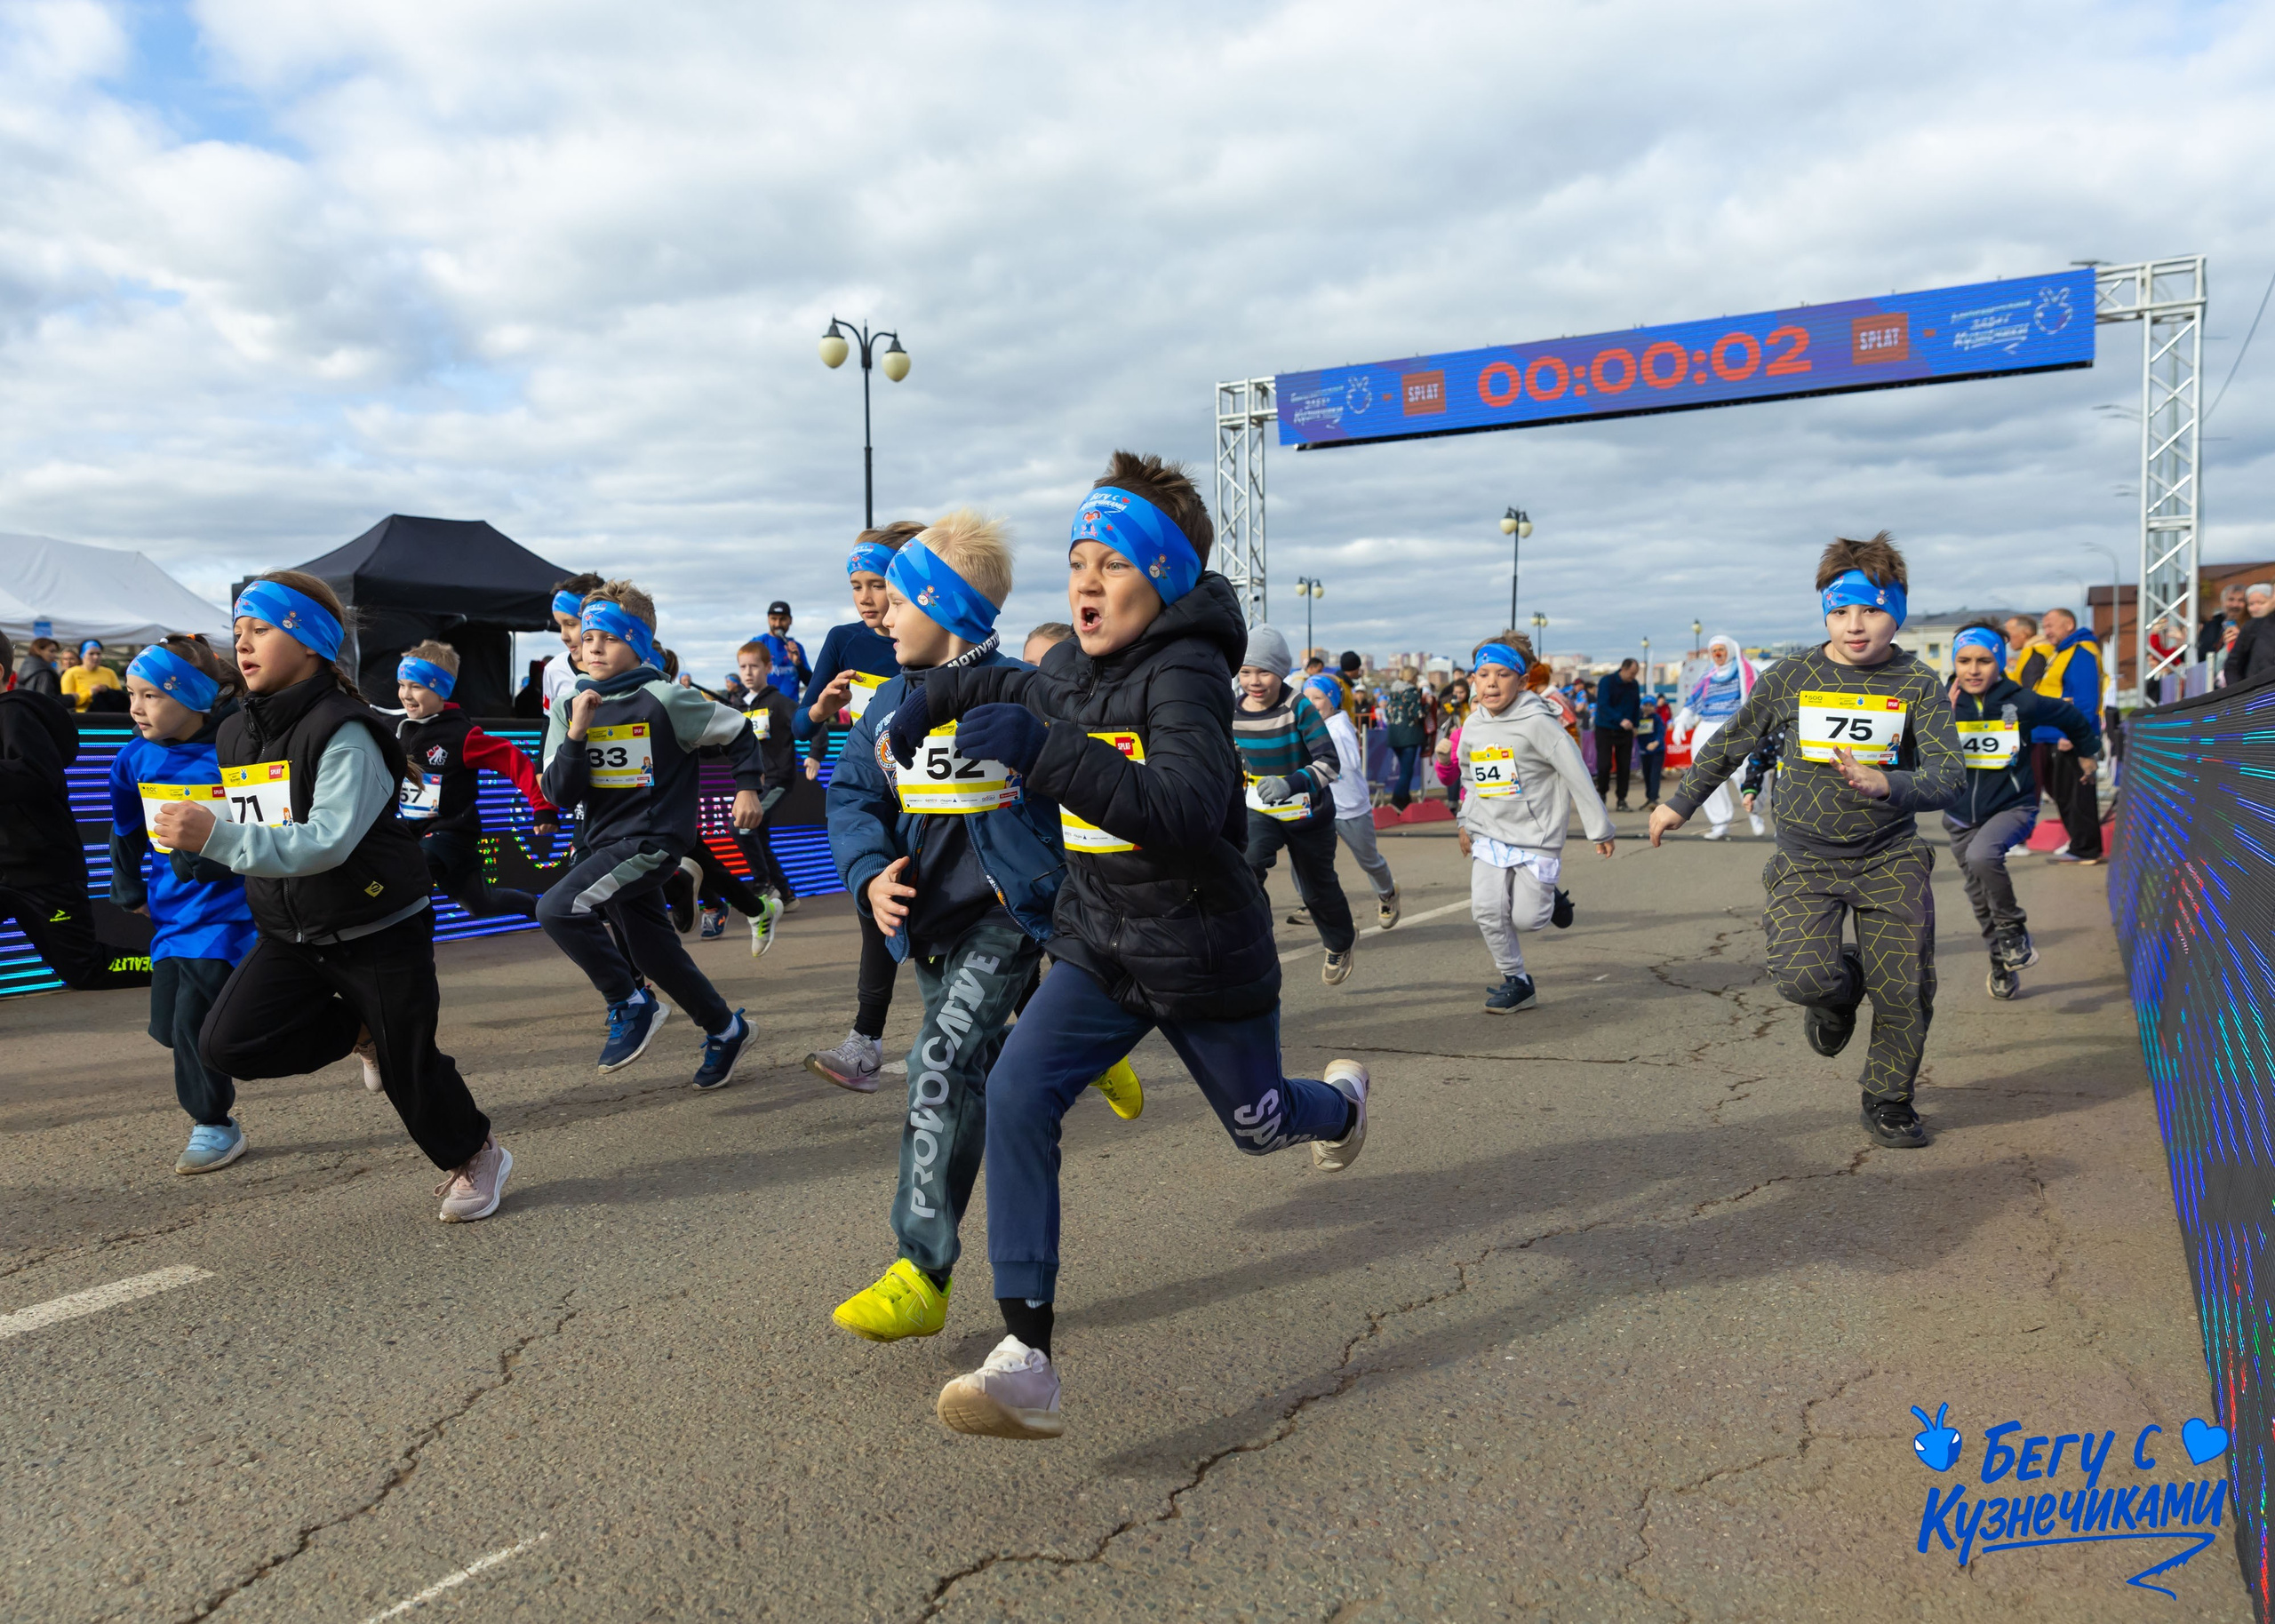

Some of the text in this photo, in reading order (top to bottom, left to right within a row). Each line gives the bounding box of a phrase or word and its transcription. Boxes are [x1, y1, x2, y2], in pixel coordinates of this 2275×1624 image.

[1859, 327, 1901, 351] SPLAT
[1478, 325, 1812, 408] 00:00:02
[1407, 383, 1440, 403] SPLAT
[1825, 716, 1872, 742] 75
[1117, 741, 1131, 751] SPLAT
[1963, 736, 2000, 753] 49
[926, 747, 986, 781] 52
[1475, 765, 1501, 782] 54
[231, 795, 264, 824] 71
[910, 951, 1001, 1218] PROVOCATIVE
